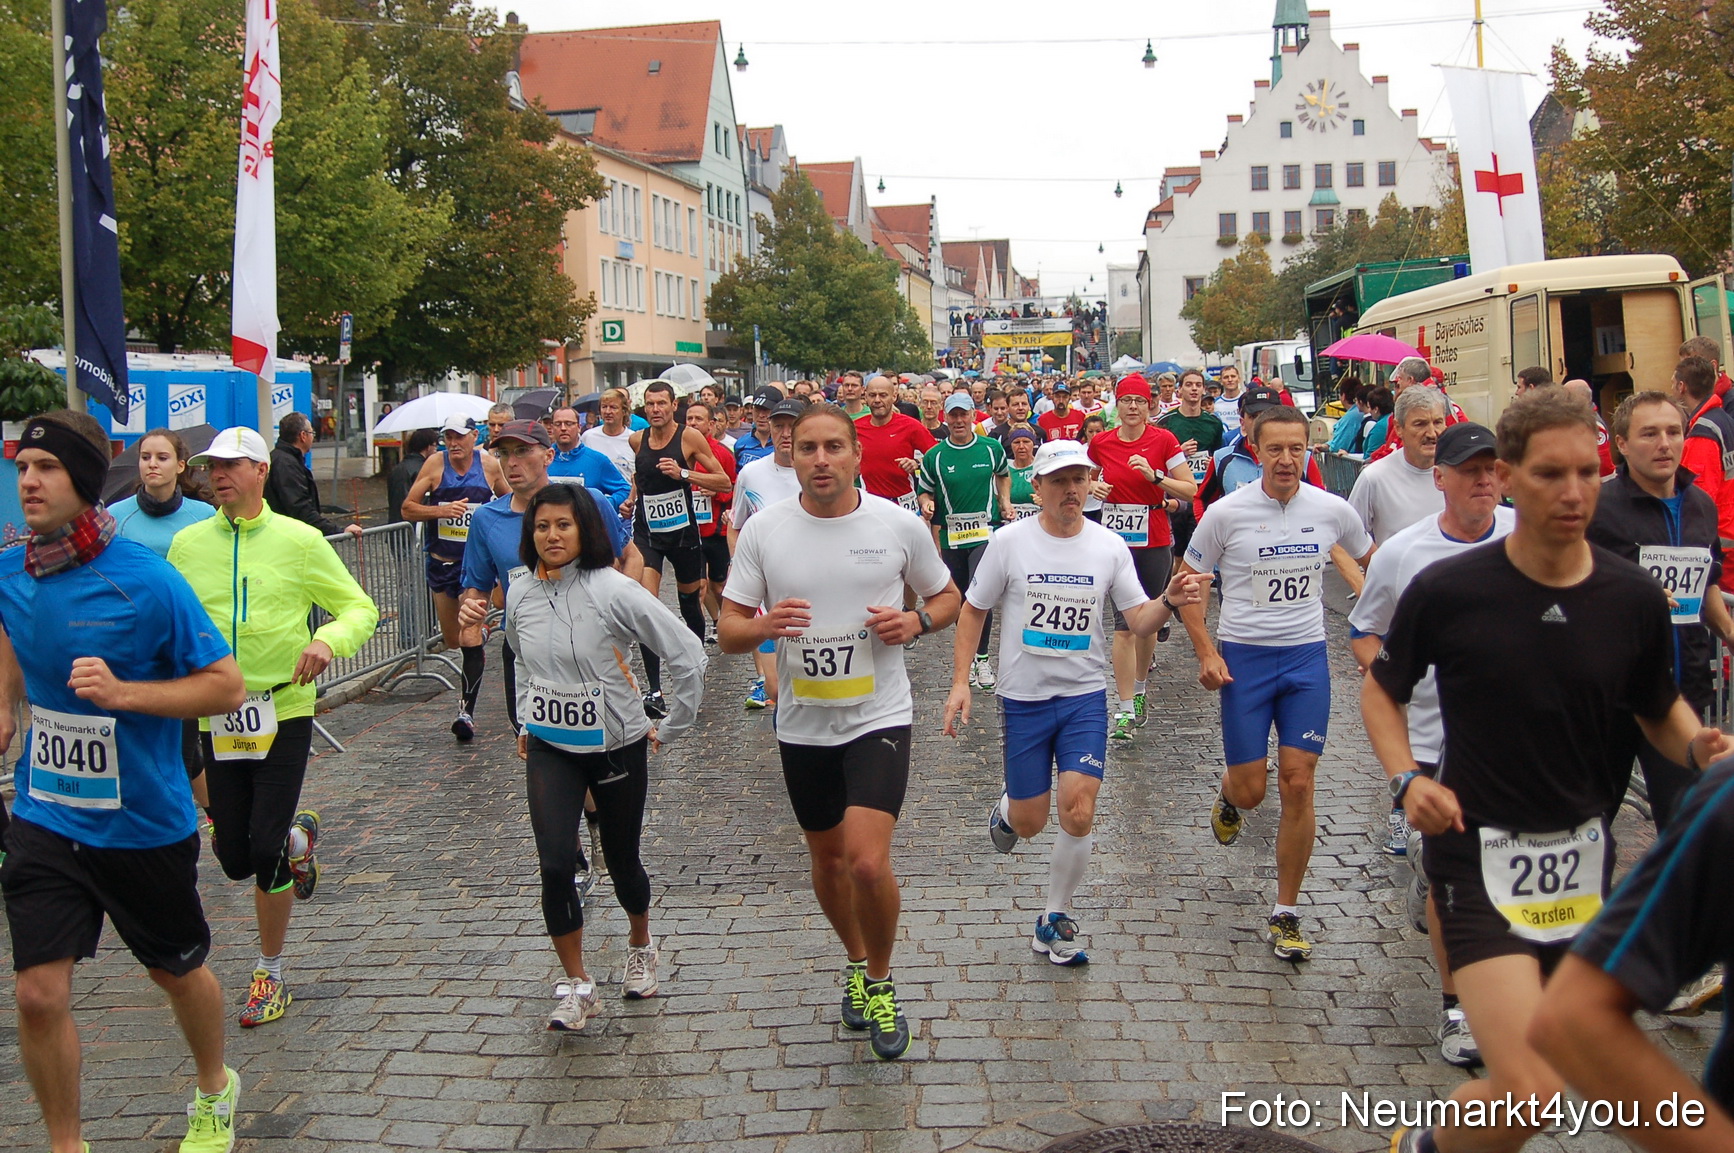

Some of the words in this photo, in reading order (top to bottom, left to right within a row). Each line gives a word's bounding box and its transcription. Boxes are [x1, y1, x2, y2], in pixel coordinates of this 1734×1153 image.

[344, 318, 351, 339] P
[605, 323, 621, 340] D
[1435, 315, 1484, 343] Bayerisches
[1011, 336, 1042, 345] START
[1435, 346, 1458, 364] Rotes
[1444, 371, 1457, 386] euz
[649, 500, 683, 519] 2086
[1106, 514, 1144, 531] 2547
[1641, 553, 1668, 562] PARTL
[1669, 554, 1703, 563] Neumarkt
[1253, 569, 1278, 577] PARTL
[1279, 566, 1313, 575] Neumarkt
[1027, 590, 1052, 601] PARTL
[1053, 594, 1089, 604] Neumarkt
[1268, 575, 1310, 603] 262
[1030, 602, 1092, 632] 2435
[786, 635, 811, 645] PARTL
[813, 633, 855, 644] Neumarkt
[1044, 636, 1071, 650] Harry
[802, 645, 854, 677] 537
[529, 682, 550, 695] PARTL
[551, 688, 589, 699] Neumarkt
[223, 706, 261, 734] 330
[532, 695, 597, 727] 3068
[33, 714, 53, 729] PARTL
[53, 721, 97, 735] Neumarkt
[37, 730, 107, 774] 3040
[57, 778, 80, 795] Ralf
[1484, 838, 1525, 850] PARTL
[1527, 832, 1584, 849] Neumarkt
[1509, 848, 1581, 898] 282
[1521, 906, 1576, 926] Carsten
